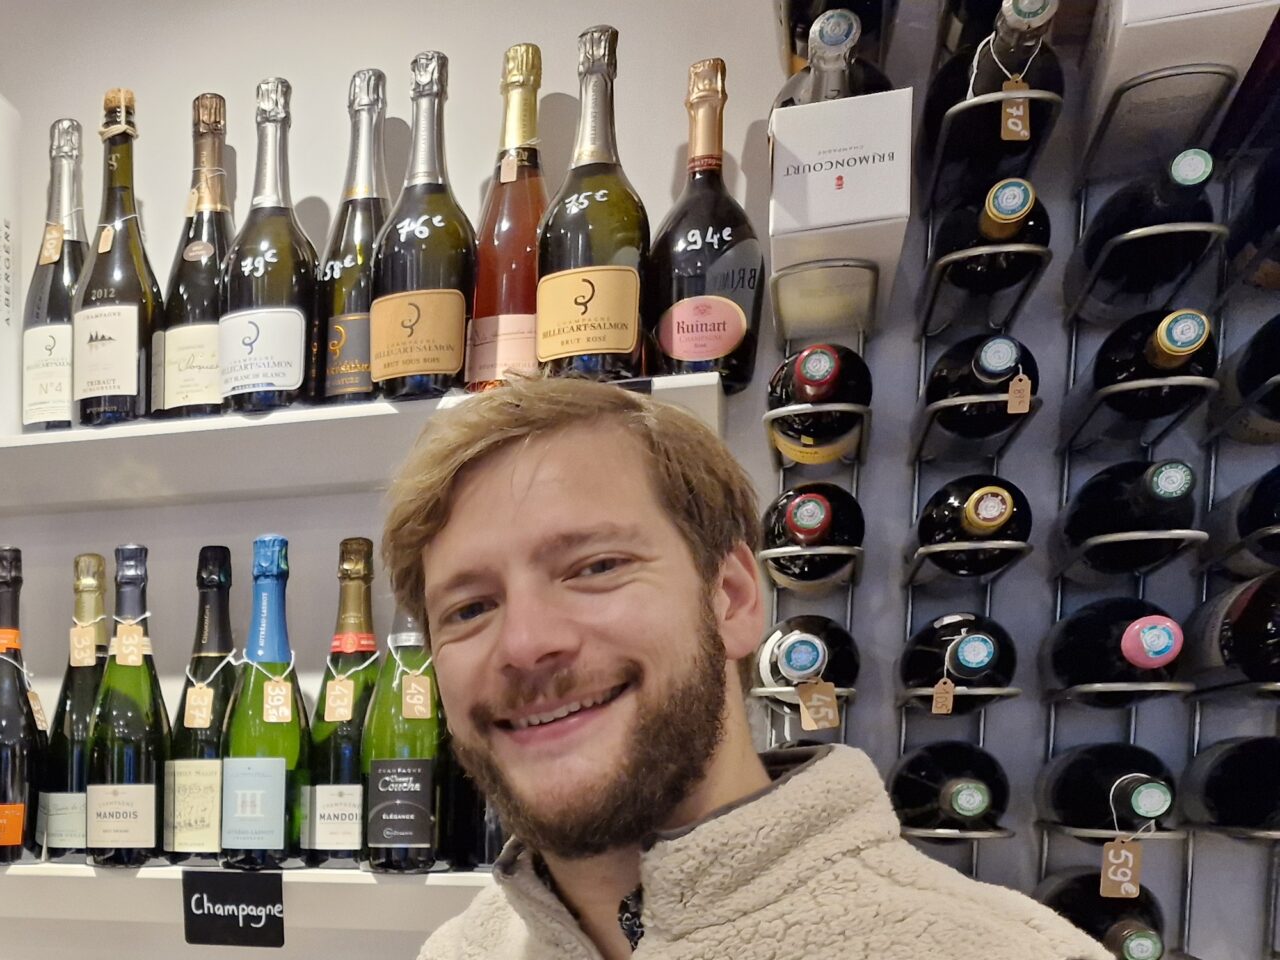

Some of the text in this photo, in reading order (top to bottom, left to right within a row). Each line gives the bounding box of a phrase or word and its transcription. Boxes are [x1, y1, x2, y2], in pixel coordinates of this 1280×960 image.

[784, 151, 896, 177] BRIMONCOURT
[91, 287, 117, 300] 2012
[676, 319, 728, 335] Ruinart
[560, 337, 581, 347] BRUT
[95, 810, 139, 820] MANDOIS
[319, 812, 359, 821] MANDOI
[1106, 848, 1137, 896] 59€
[190, 893, 284, 929] Champagne
